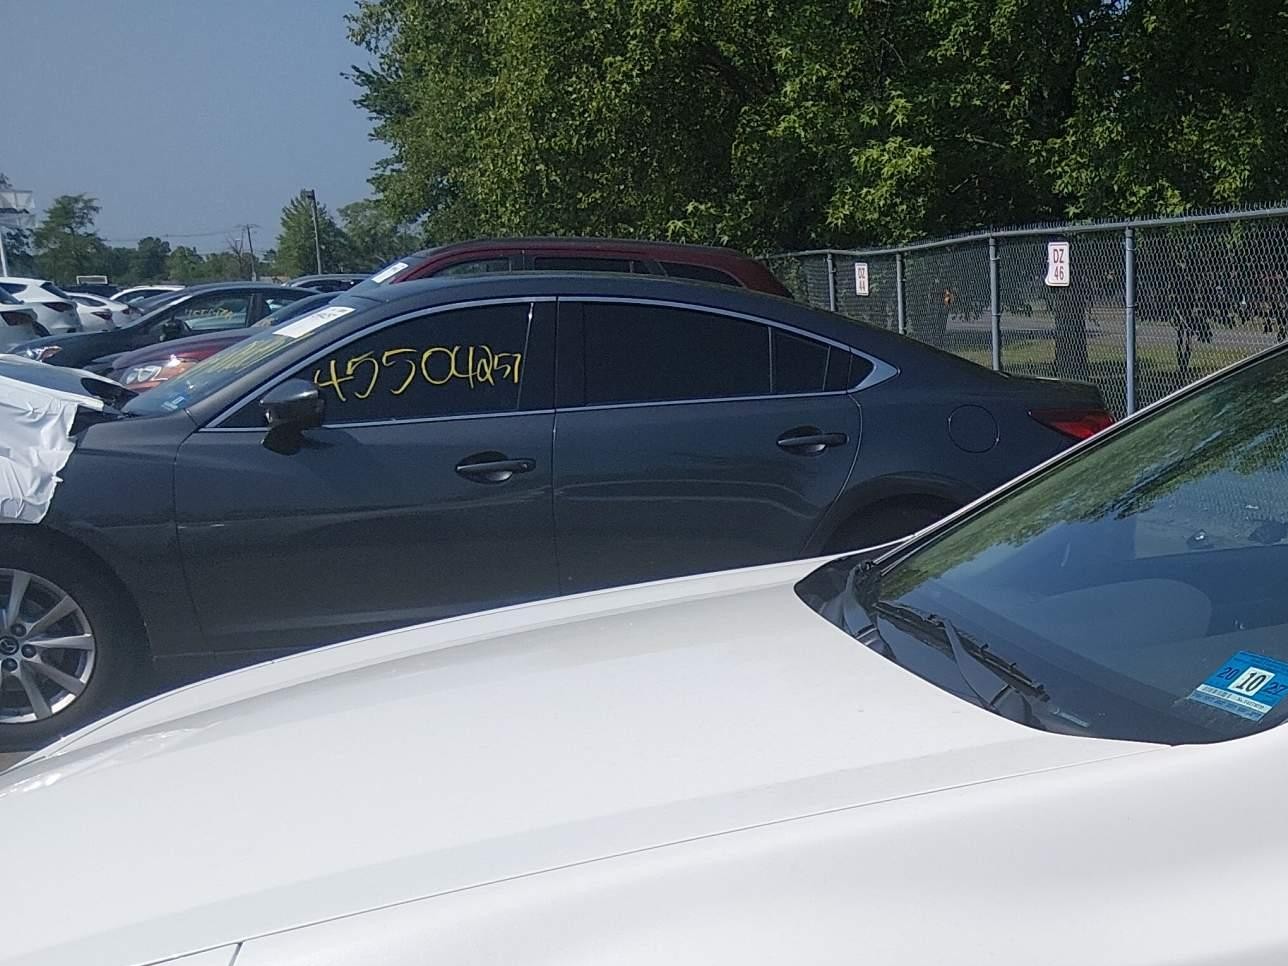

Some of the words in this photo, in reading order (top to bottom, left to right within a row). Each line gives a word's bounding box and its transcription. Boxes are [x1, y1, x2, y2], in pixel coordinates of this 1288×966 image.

[1053, 248, 1065, 264] DZ
[1054, 266, 1065, 281] 46
[1216, 666, 1240, 681] 20
[1235, 671, 1267, 692] 10
